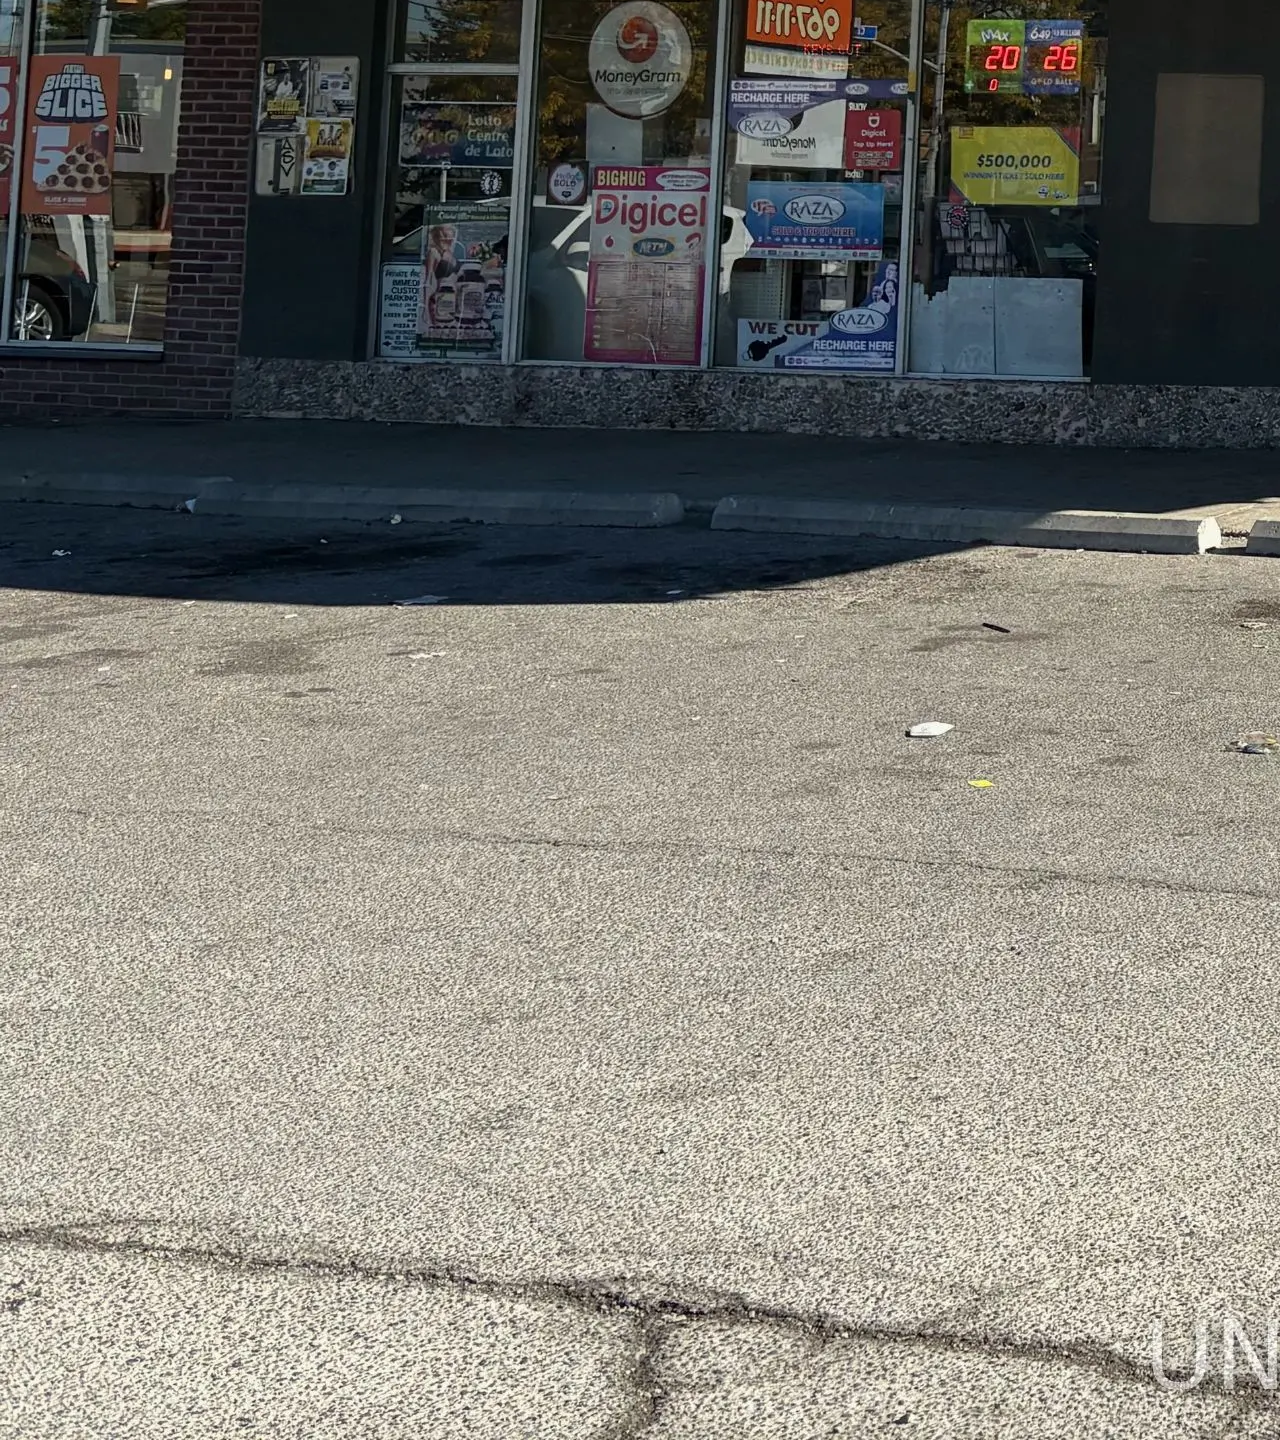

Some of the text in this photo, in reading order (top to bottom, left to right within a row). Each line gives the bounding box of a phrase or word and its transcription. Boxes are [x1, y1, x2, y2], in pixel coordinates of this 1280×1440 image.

[981, 28, 1010, 42] MAX
[1030, 27, 1050, 40] 649
[984, 45, 1021, 70] 20
[1043, 45, 1078, 70] 26
[44, 74, 103, 92] BIGGER
[595, 69, 681, 86] MoneyGram
[35, 90, 108, 118] SLICE
[731, 93, 810, 102] RECHARGE HERE
[744, 119, 781, 133] RAZA
[977, 153, 1052, 170] $500,000
[597, 170, 646, 186] BIGHUG
[595, 193, 707, 234] Digicel
[790, 201, 833, 218] RAZA
[748, 321, 820, 336] WE CUT
[838, 314, 875, 328] RAZA
[812, 340, 895, 351] RECHARGE HERE
